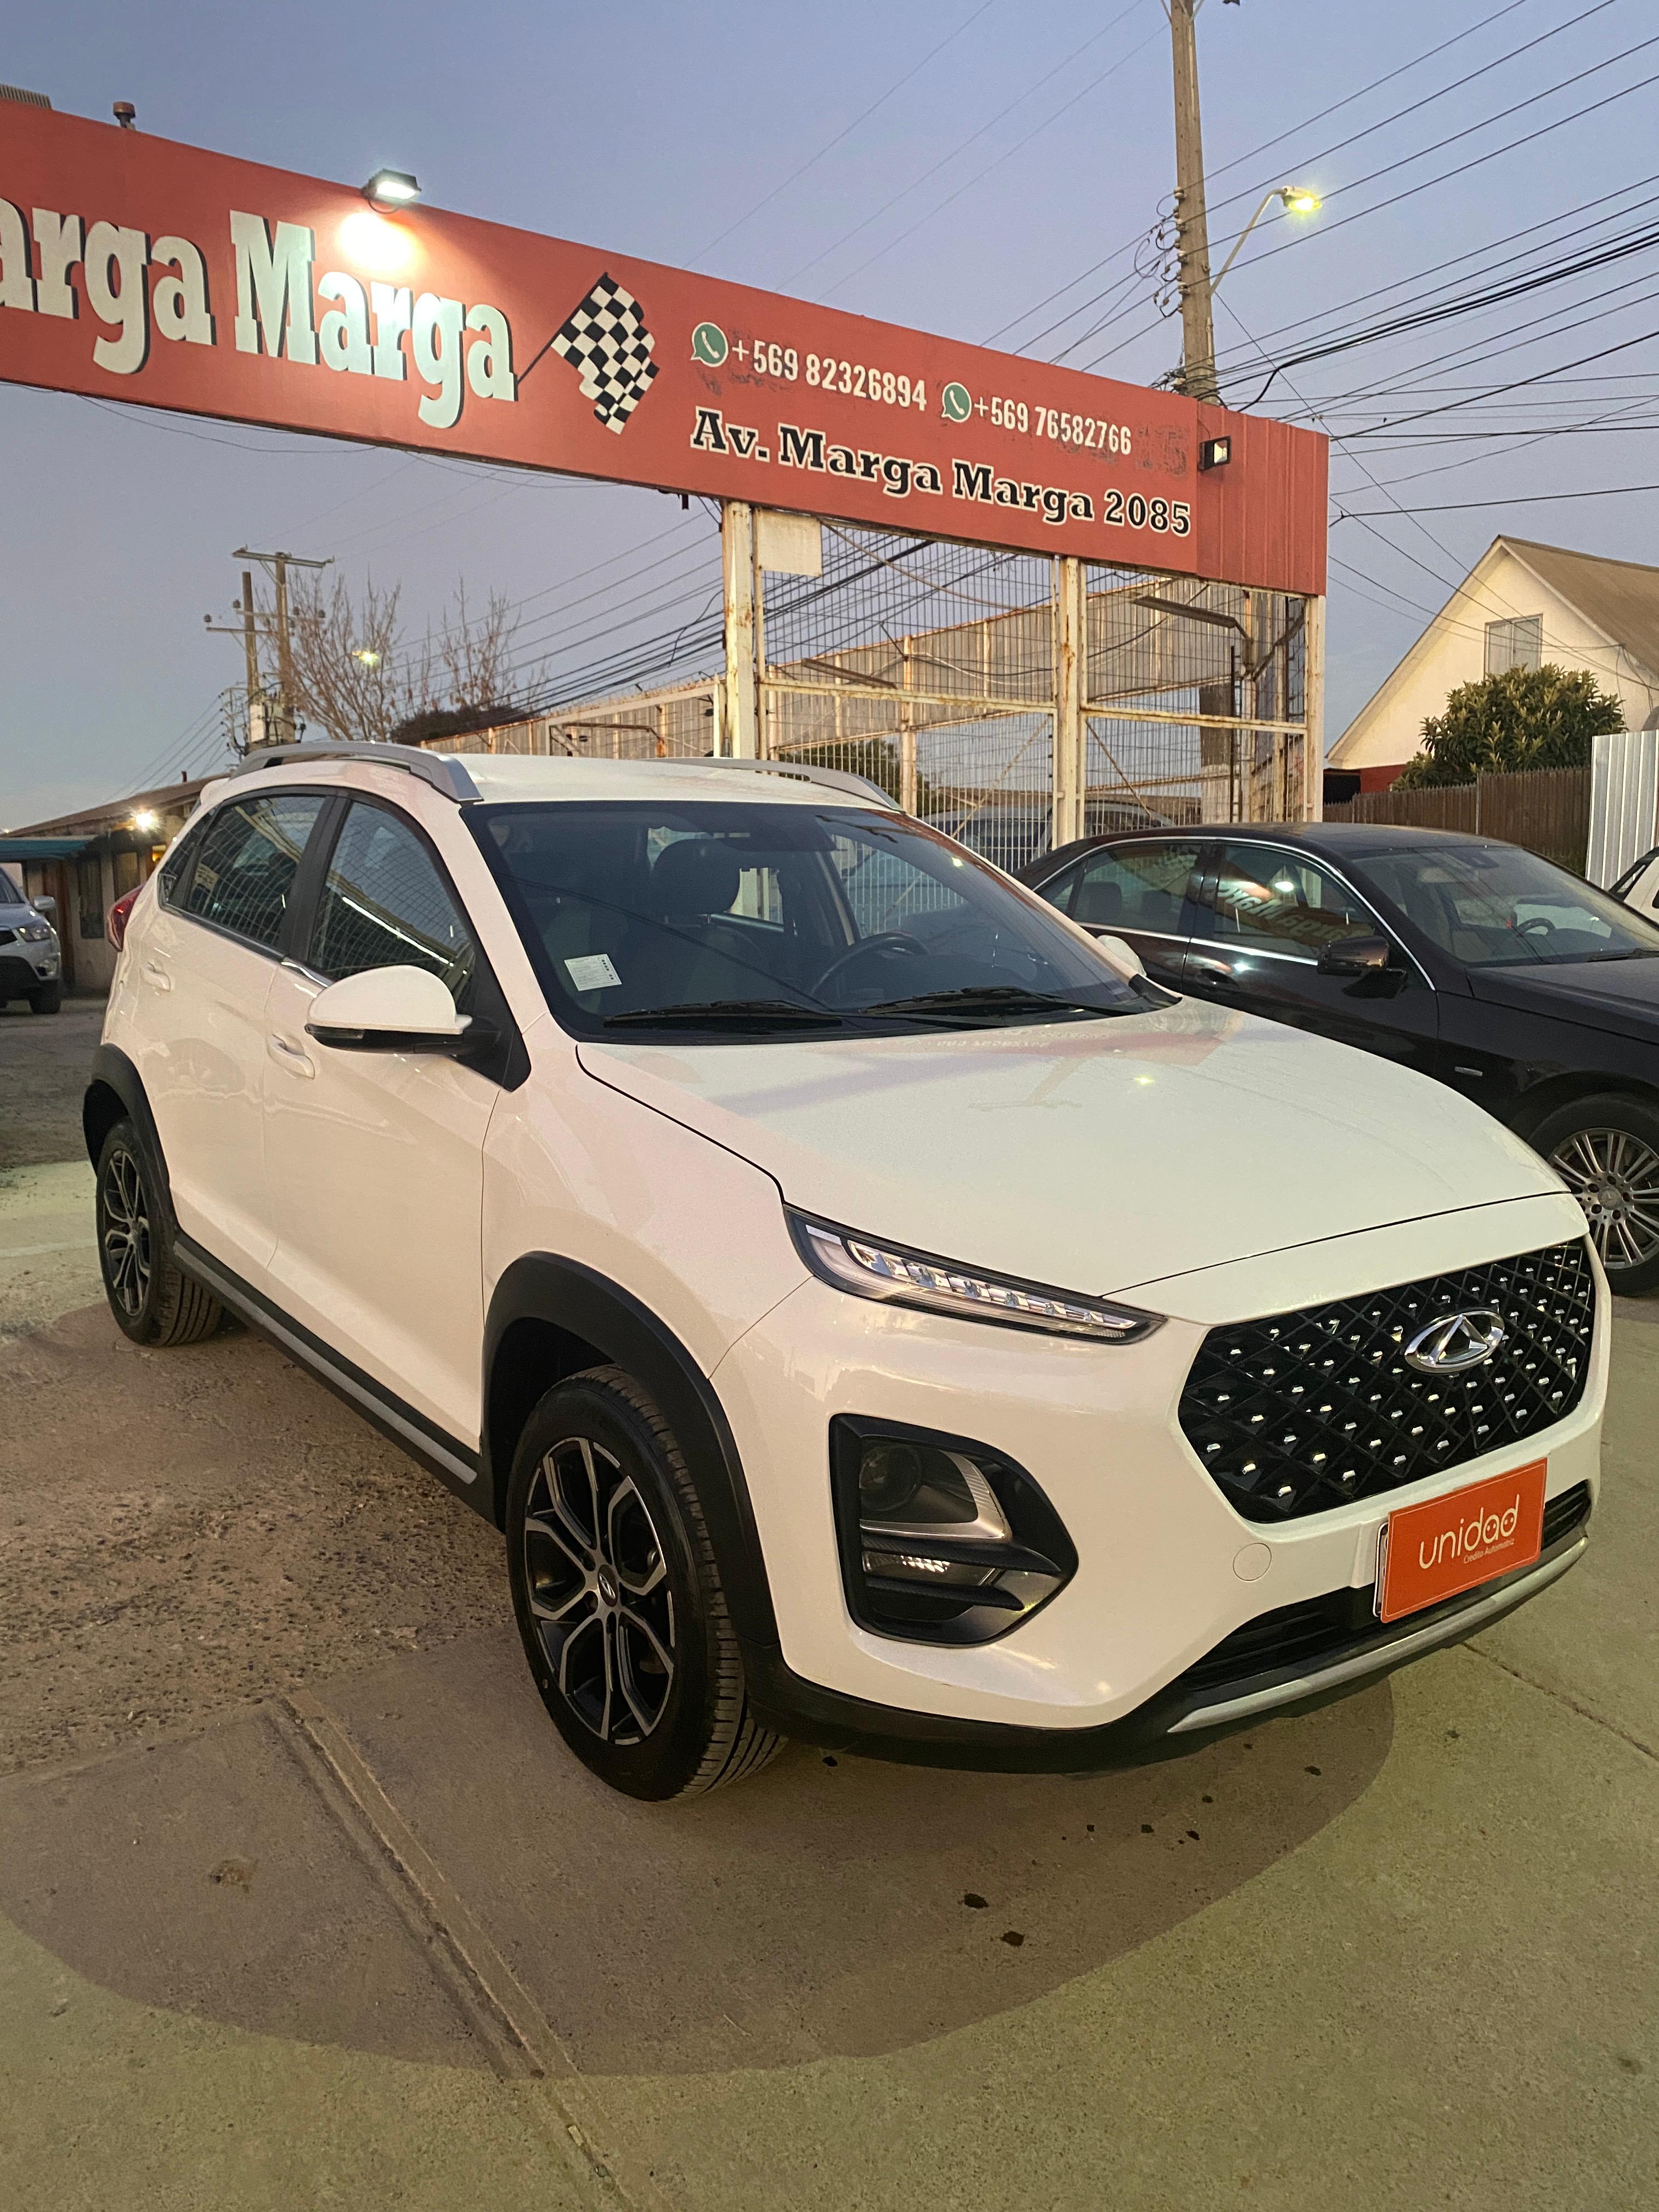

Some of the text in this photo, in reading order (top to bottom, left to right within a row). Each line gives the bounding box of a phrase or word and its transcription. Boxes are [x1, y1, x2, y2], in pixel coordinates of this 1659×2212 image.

[229, 210, 518, 429] Marga
[732, 340, 927, 411] +569 82326894
[974, 396, 1132, 455] +569 76582766
[690, 405, 1191, 538] Av. Marga Marga 2085
[1419, 1493, 1520, 1569] unidad
